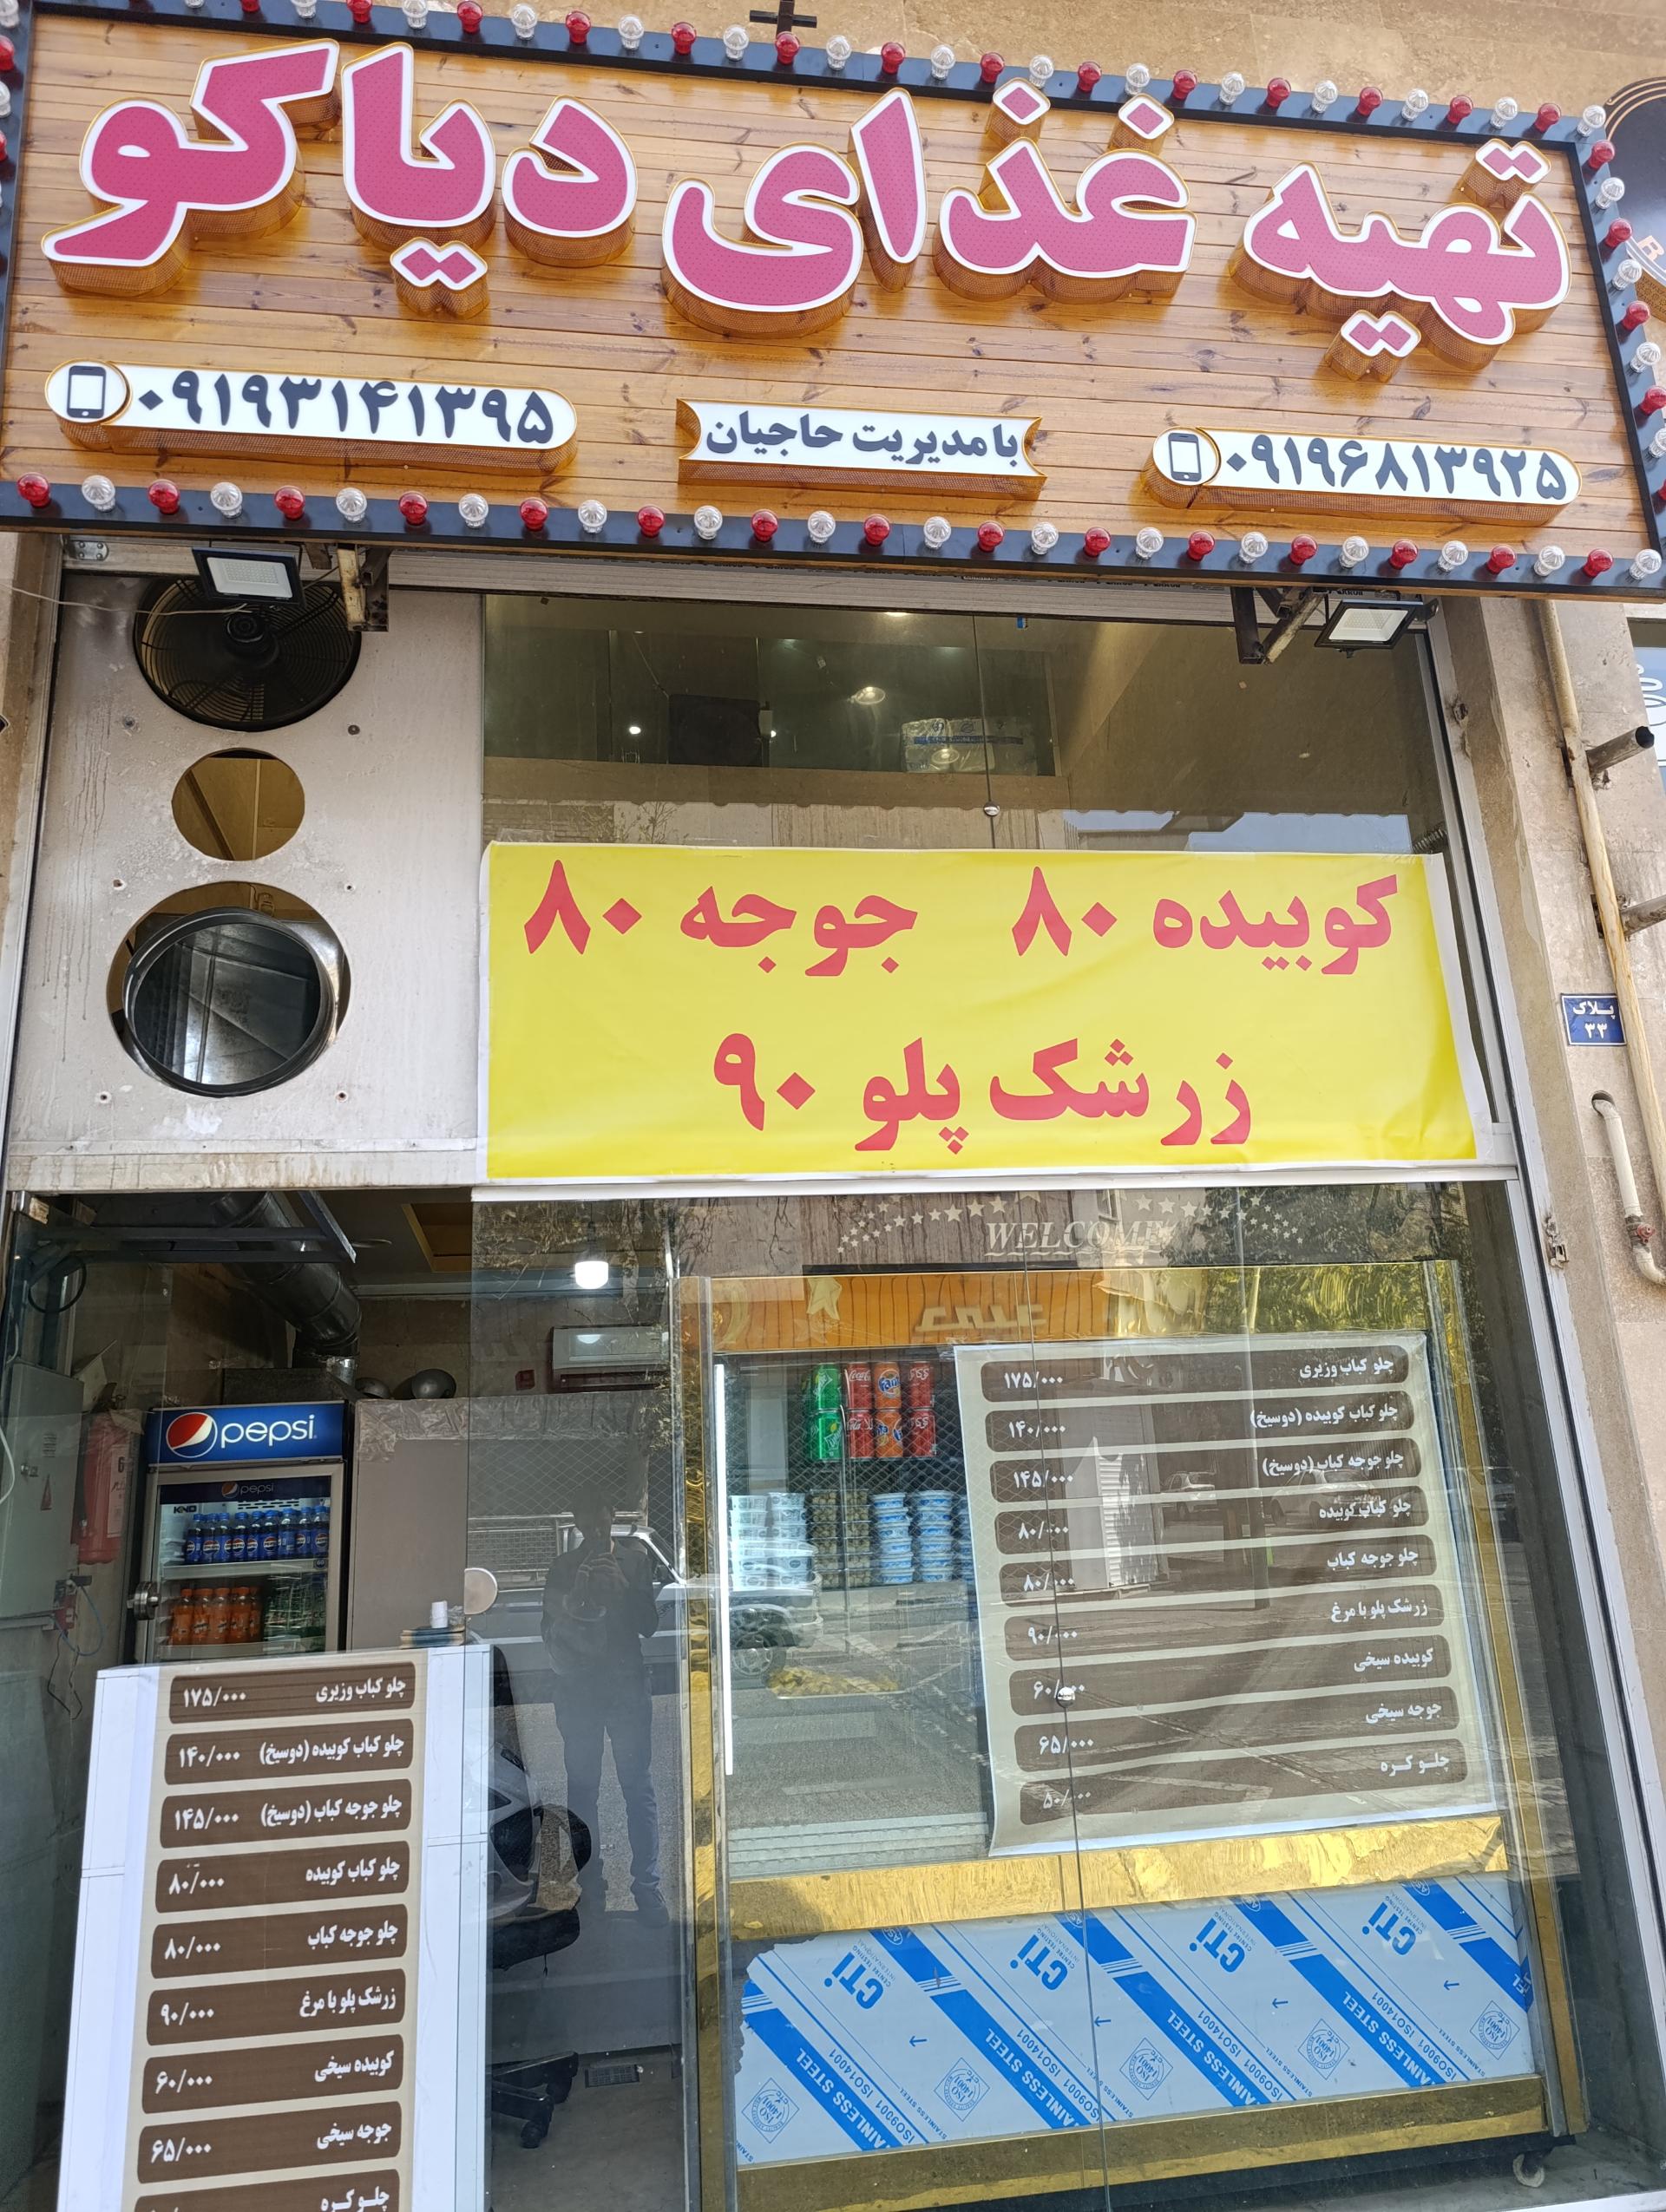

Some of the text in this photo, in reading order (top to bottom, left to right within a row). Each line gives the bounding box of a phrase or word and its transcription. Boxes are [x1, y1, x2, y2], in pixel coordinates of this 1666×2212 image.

[42, 38, 1571, 358] تهیه غذای دیاکو
[138, 369, 554, 445] ۰۹۱۹۳۱۴۱۳۹۵
[706, 410, 844, 457] حاجیان
[1227, 433, 1564, 501] ۰۹۱۹۶۸۱۳۹۲۵
[524, 860, 1399, 978] کوبیده ۸۰ جوجه ۸۰
[1572, 1000, 1615, 1020] پلاک
[1584, 1023, 1608, 1039] ۳۳
[712, 1032, 1252, 1155] زرشک پلو ۹۰
[985, 1220, 1166, 1250] WELCOME
[1299, 1363, 1338, 1379] وزیری
[1340, 1358, 1368, 1376] کباب
[1374, 1356, 1394, 1375] چلو
[1305, 1405, 1345, 1425] کوبیده
[1348, 1404, 1376, 1422] کباب
[1379, 1403, 1398, 1422] چلو
[220, 1414, 315, 1449] pepsi
[1315, 1454, 1344, 1472] کباب
[1348, 1456, 1382, 1472] جوجه
[1384, 1450, 1404, 1469] چلو
[240, 1482, 274, 1495] pepsi
[1319, 1502, 1356, 1522] کوبیده
[1358, 1499, 1387, 1518] کباب
[1392, 1498, 1412, 1518] چلو
[1327, 1551, 1356, 1571] کباب
[1361, 1551, 1394, 1568] جوجه
[1398, 1547, 1419, 1567] چلو
[1330, 1601, 1356, 1623] مرغ
[1358, 1601, 1368, 1617] با
[1369, 1600, 1386, 1620] پلو
[1387, 1598, 1428, 1618] زرشک
[1033, 1647, 1434, 1700] کوبیده سیخی ۶۰/۰۰
[315, 1683, 353, 1703] وزیری
[355, 1678, 383, 1698] کباب
[385, 1676, 406, 1698] چلو
[1365, 1703, 1404, 1724] سیخی
[1407, 1702, 1443, 1720] جوجه
[312, 1737, 351, 1761] کوبیده
[352, 1735, 381, 1755] کباب
[384, 1734, 405, 1756] چلو
[313, 1798, 344, 1823] کباب
[344, 1801, 379, 1821] جوجه
[381, 1795, 403, 1817] چلو
[305, 1860, 346, 1886] کوبیده
[347, 1858, 377, 1881] کباب
[379, 1856, 401, 1879] چلو
[377, 1920, 399, 1945] چلو
[1403, 1915, 1423, 1935] CENTRE
[307, 1925, 338, 1949] کباب
[339, 1928, 374, 1947] جوجه
[1232, 1932, 1252, 1953] CENTRE
[1055, 1950, 1075, 1970] CENTRE
[873, 1967, 892, 1988] CENTRE
[299, 1991, 325, 2018] مرغ
[327, 1990, 338, 2009] با
[339, 1988, 356, 2013] پلو
[357, 1986, 397, 2010] زرشک
[1342, 1991, 1436, 2086] AINLESS STEEL
[1371, 1991, 1458, 2081] ISO9001 ISO14001
[1485, 2025, 1499, 2042] ISO
[353, 2050, 395, 2077] کوبیده
[1167, 2009, 1261, 2105] AINLESS STEEL
[1197, 2010, 1283, 2101] ISO9001 ISO14001
[1313, 2045, 1328, 2062] ISO
[1454, 2045, 1486, 2078] STAINLESS
[314, 2055, 351, 2082] سیخی
[985, 2027, 1079, 2127] AINLESS STEEL
[1016, 2028, 1101, 2122] ISO9001 ISO14001
[1136, 2065, 1151, 2083] ISO
[1282, 2065, 1313, 2097] STAINLESS
[796, 2046, 892, 2149] AINLESS STEEL
[828, 2048, 915, 2143] ISO9001 ISO14001
[950, 2085, 966, 2104] ISO
[1103, 2084, 1134, 2119] STAINLESS
[759, 2105, 775, 2124] ISO
[916, 2106, 948, 2141] STAINLESS
[317, 2122, 354, 2150] سیخی
[357, 2122, 392, 2144] جوجه
